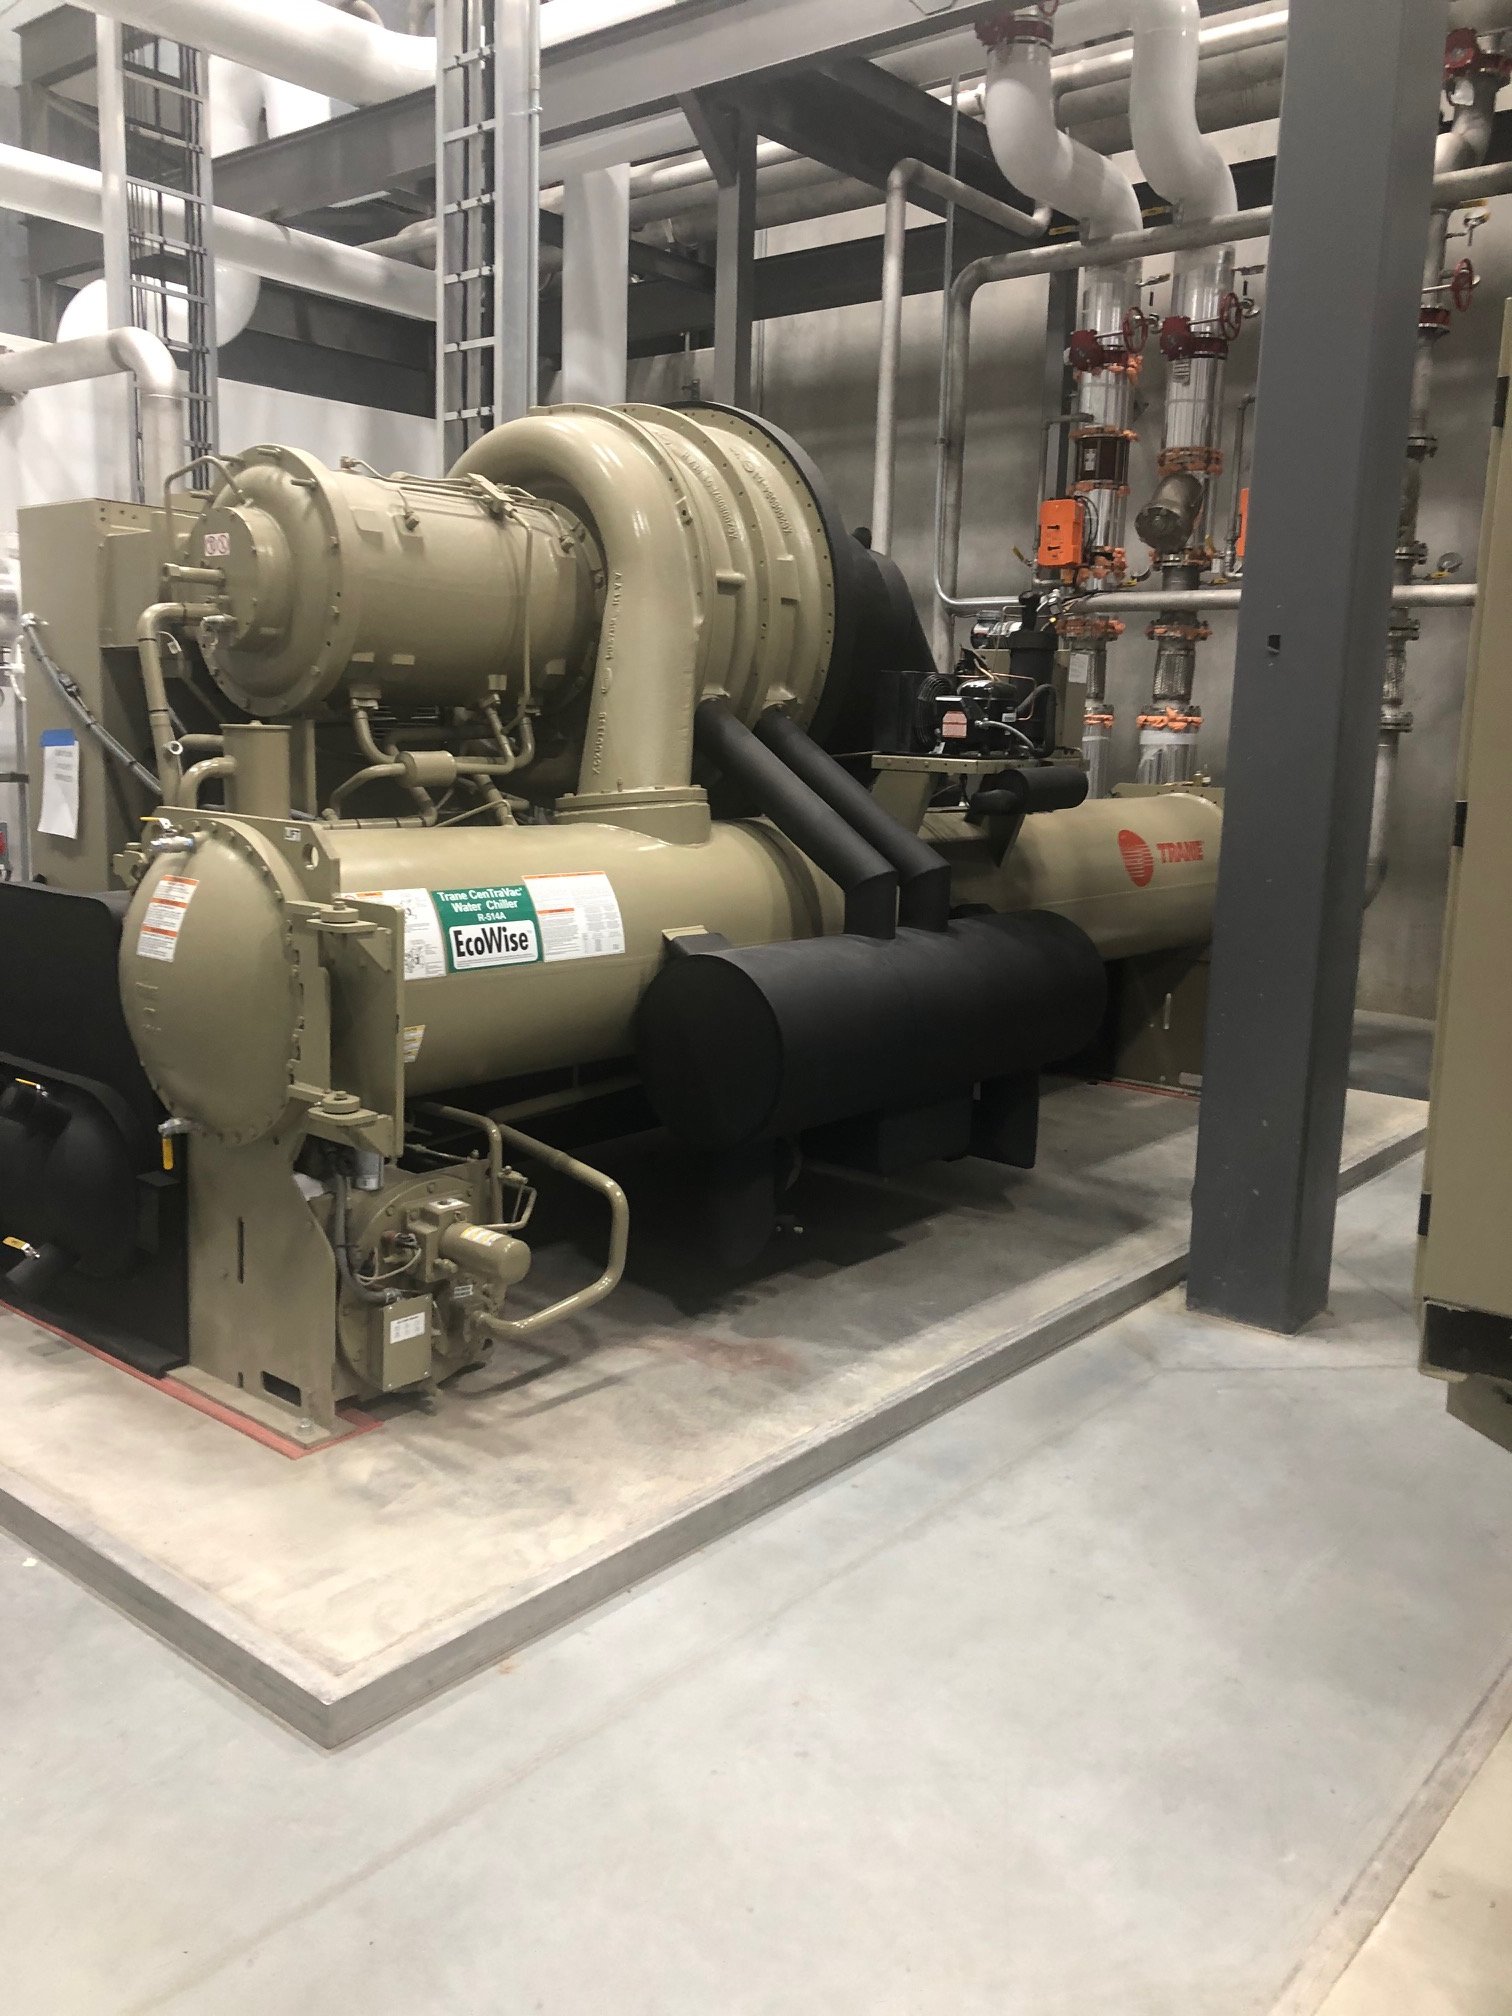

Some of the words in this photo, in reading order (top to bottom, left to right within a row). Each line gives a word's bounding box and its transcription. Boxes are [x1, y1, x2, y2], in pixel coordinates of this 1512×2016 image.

[1156, 840, 1204, 863] TRANE
[437, 891, 468, 901] Trane
[451, 902, 481, 913] Water
[486, 899, 518, 910] Chiller
[477, 912, 507, 921] R-514A
[453, 926, 529, 957] EcoWise
